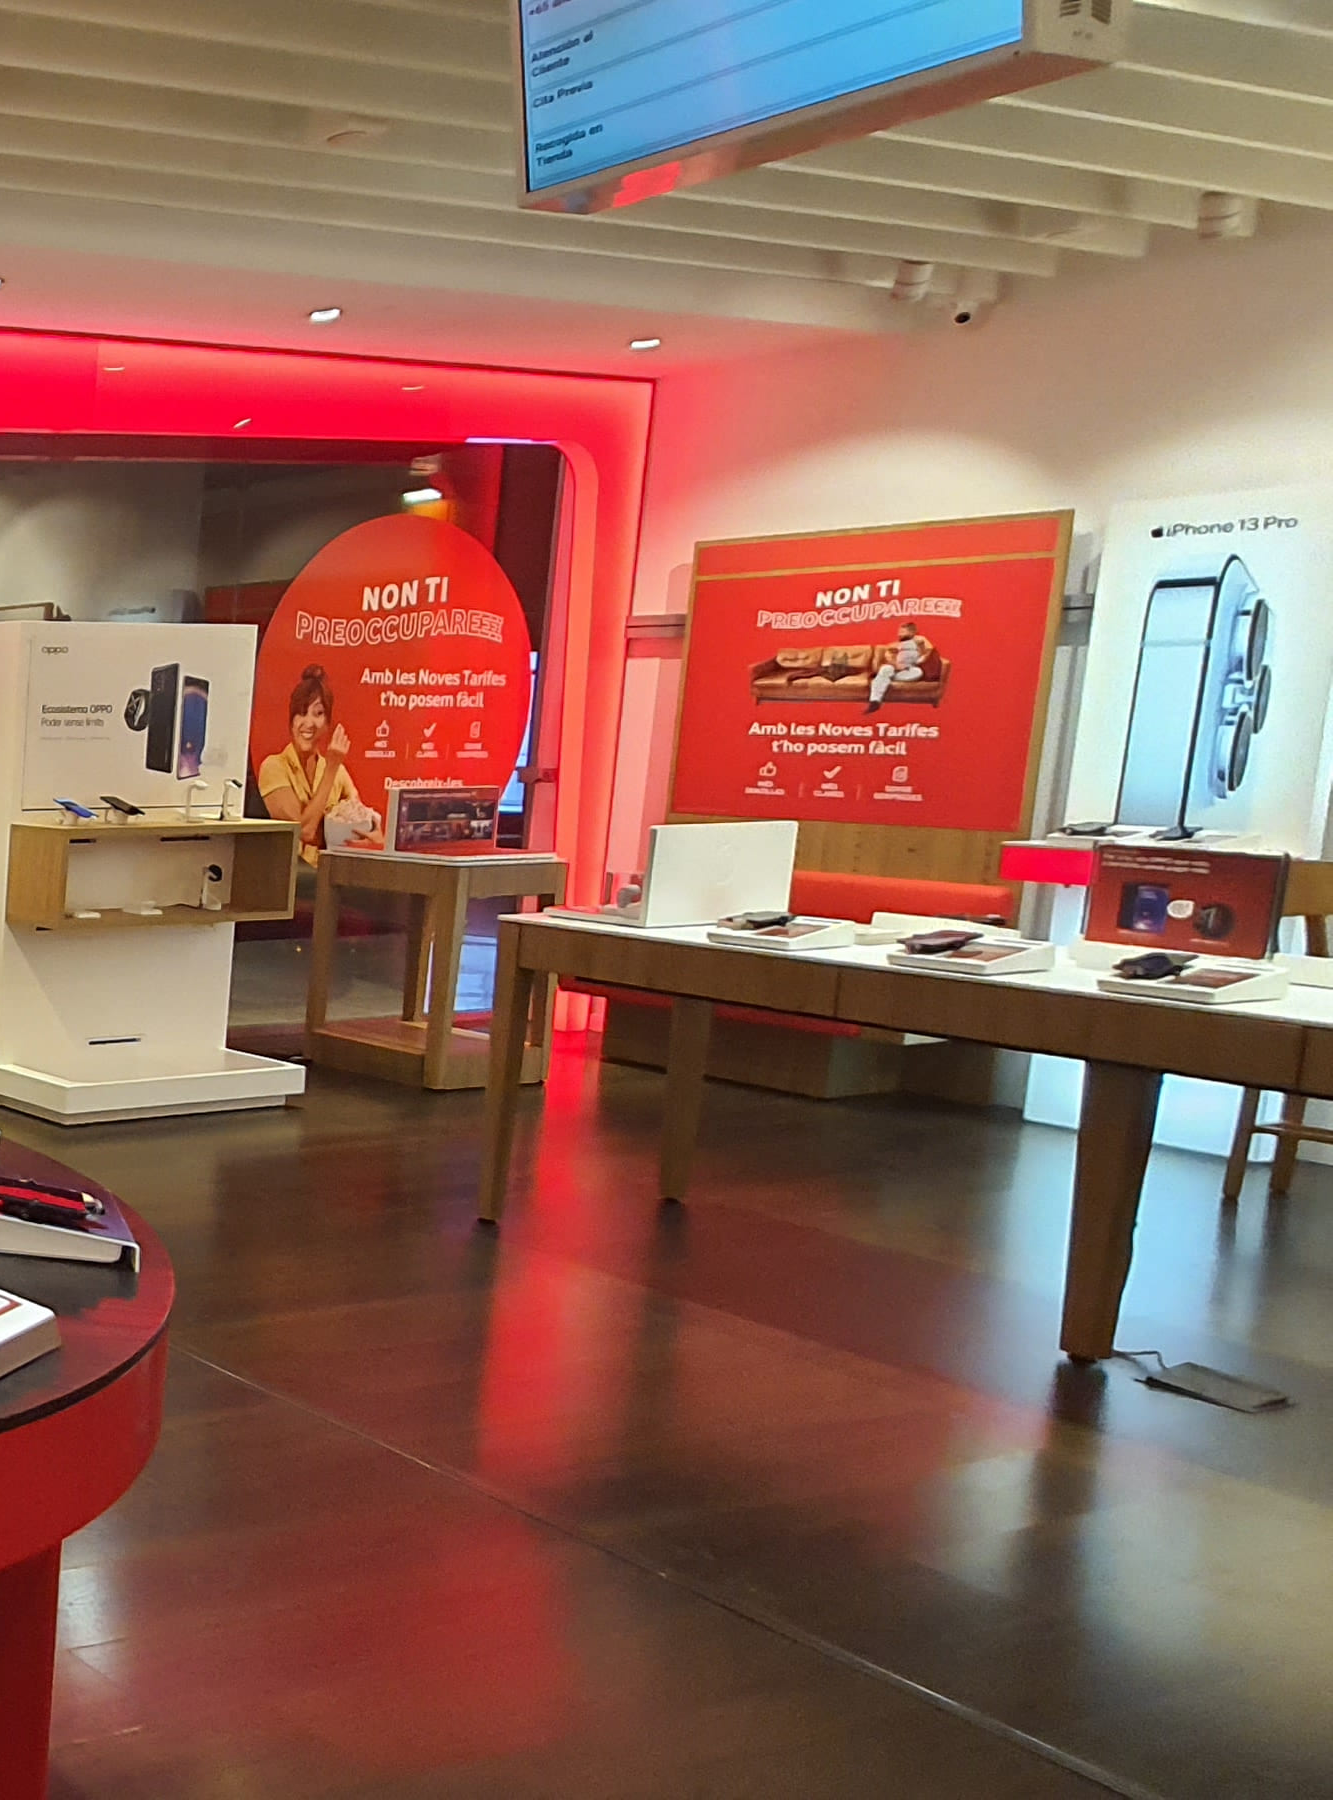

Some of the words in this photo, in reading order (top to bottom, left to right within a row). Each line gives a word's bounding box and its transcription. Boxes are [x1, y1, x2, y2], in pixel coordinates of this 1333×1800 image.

[1165, 521, 1235, 538] iPhone
[1238, 516, 1260, 532] 13
[1263, 515, 1299, 530] Pro
[361, 579, 420, 613] NON
[425, 576, 450, 603] TI
[815, 583, 872, 609] NON
[876, 579, 902, 598] TI
[360, 667, 393, 685] Amb
[396, 668, 416, 685] les
[418, 668, 461, 686] Noves
[462, 669, 507, 687] Tarifes
[90, 704, 113, 714] OPPO
[380, 690, 407, 708] t'ho
[408, 693, 454, 711] posem
[455, 691, 485, 709] fàcil
[748, 721, 788, 736] Amb
[790, 722, 816, 736] les
[818, 722, 873, 737] Noves
[876, 722, 940, 738] Tarifes
[771, 739, 805, 753] t'ho
[806, 742, 865, 756] posem
[868, 739, 907, 755] fàcil
